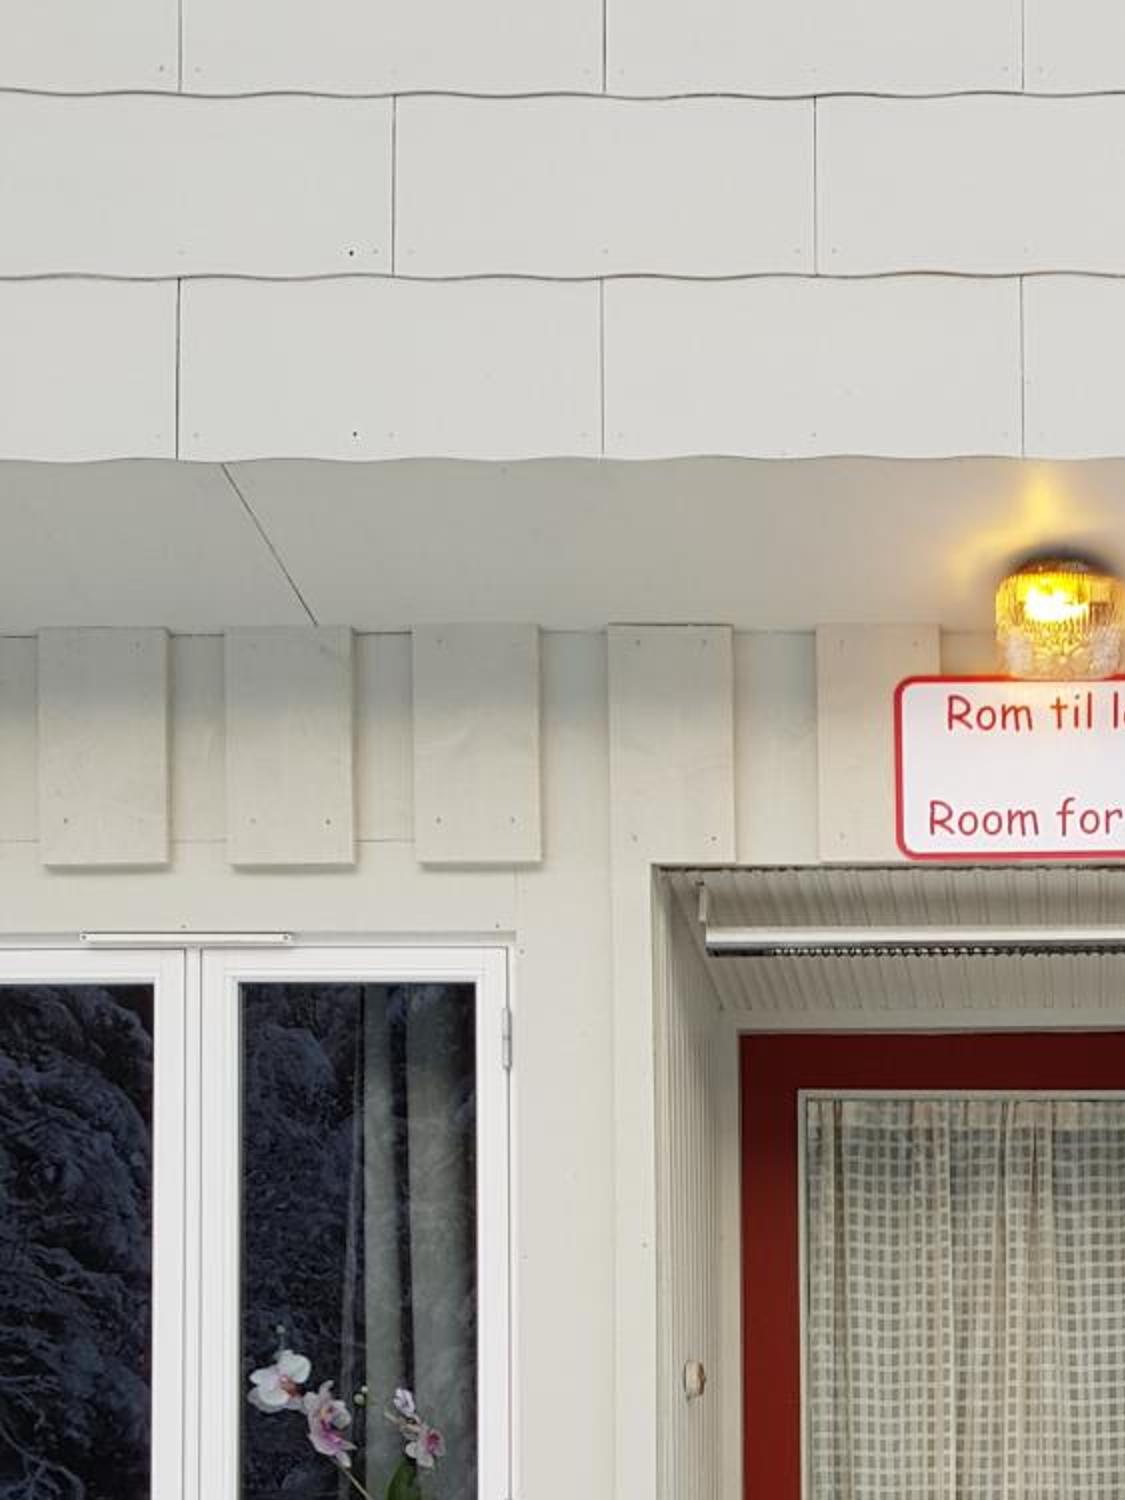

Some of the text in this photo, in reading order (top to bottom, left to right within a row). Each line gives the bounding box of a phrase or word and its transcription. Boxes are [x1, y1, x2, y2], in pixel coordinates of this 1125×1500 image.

[947, 694, 1033, 732] Rom
[1050, 692, 1093, 729] til
[929, 800, 1040, 837] Room
[1056, 797, 1123, 837] for
